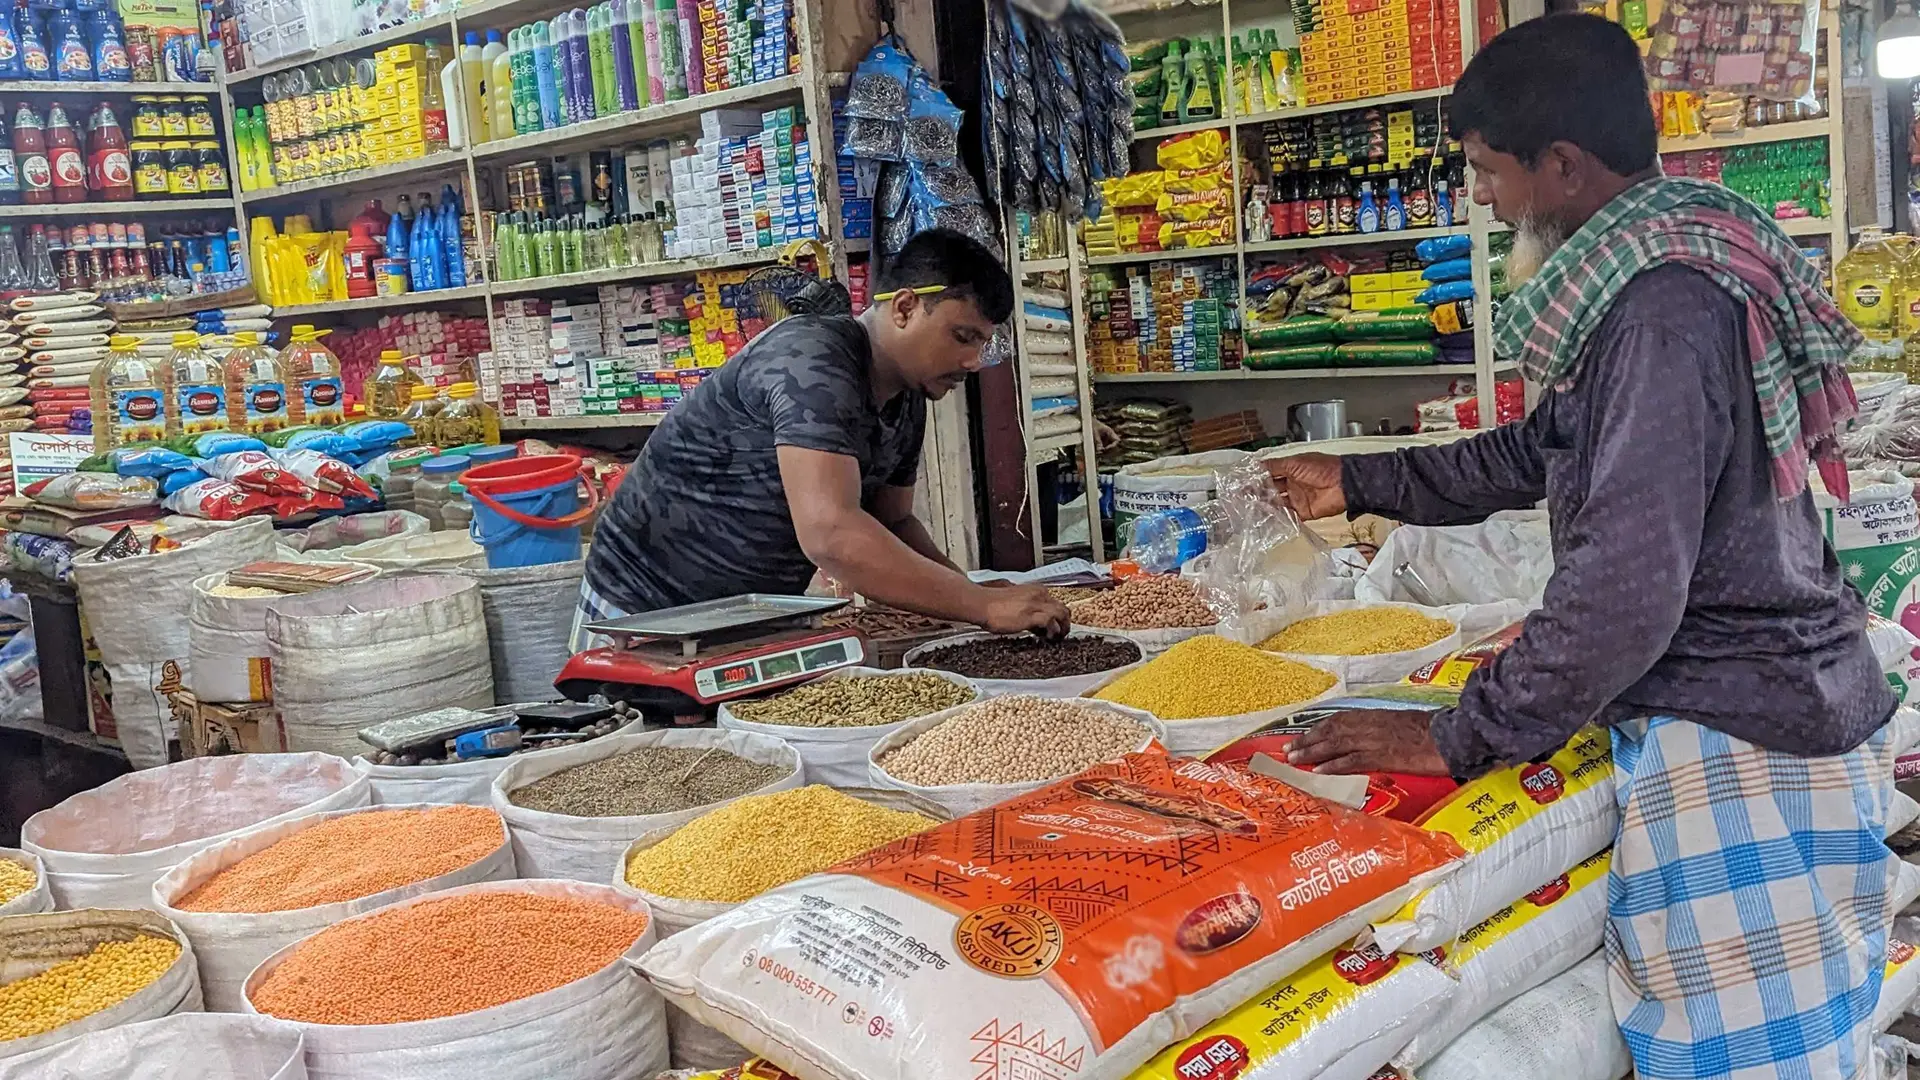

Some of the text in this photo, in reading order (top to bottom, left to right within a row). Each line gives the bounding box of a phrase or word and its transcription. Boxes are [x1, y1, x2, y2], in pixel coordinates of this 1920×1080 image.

[126, 401, 158, 413] Basmah
[189, 397, 219, 408] Basmah
[254, 394, 281, 405] Basmah
[311, 388, 336, 399] Basmah
[31, 440, 71, 453] মেসার্স
[1466, 792, 1494, 814] সুপার
[1469, 799, 1519, 837] আটাইশ চাউল
[1289, 838, 1342, 870] প্রিমিয়াম
[1277, 847, 1385, 911] কাটারি ঘি ভোগ
[981, 920, 1036, 955] AKIJ
[1001, 904, 1059, 946] QUALITY
[1458, 905, 1517, 944] আটাইশ চাউল
[899, 935, 951, 970] লিমিটেড
[960, 930, 1017, 973] ASSURED
[1337, 951, 1368, 974] পদ্মা
[758, 956, 773, 974] 08
[773, 963, 795, 984] 000
[794, 975, 816, 995] 555
[814, 985, 838, 1006] 777
[1260, 984, 1300, 1012] সুপার
[1261, 986, 1335, 1038] আটাইশ চাউল
[1178, 1038, 1240, 1080] পদ্মা সেতু
